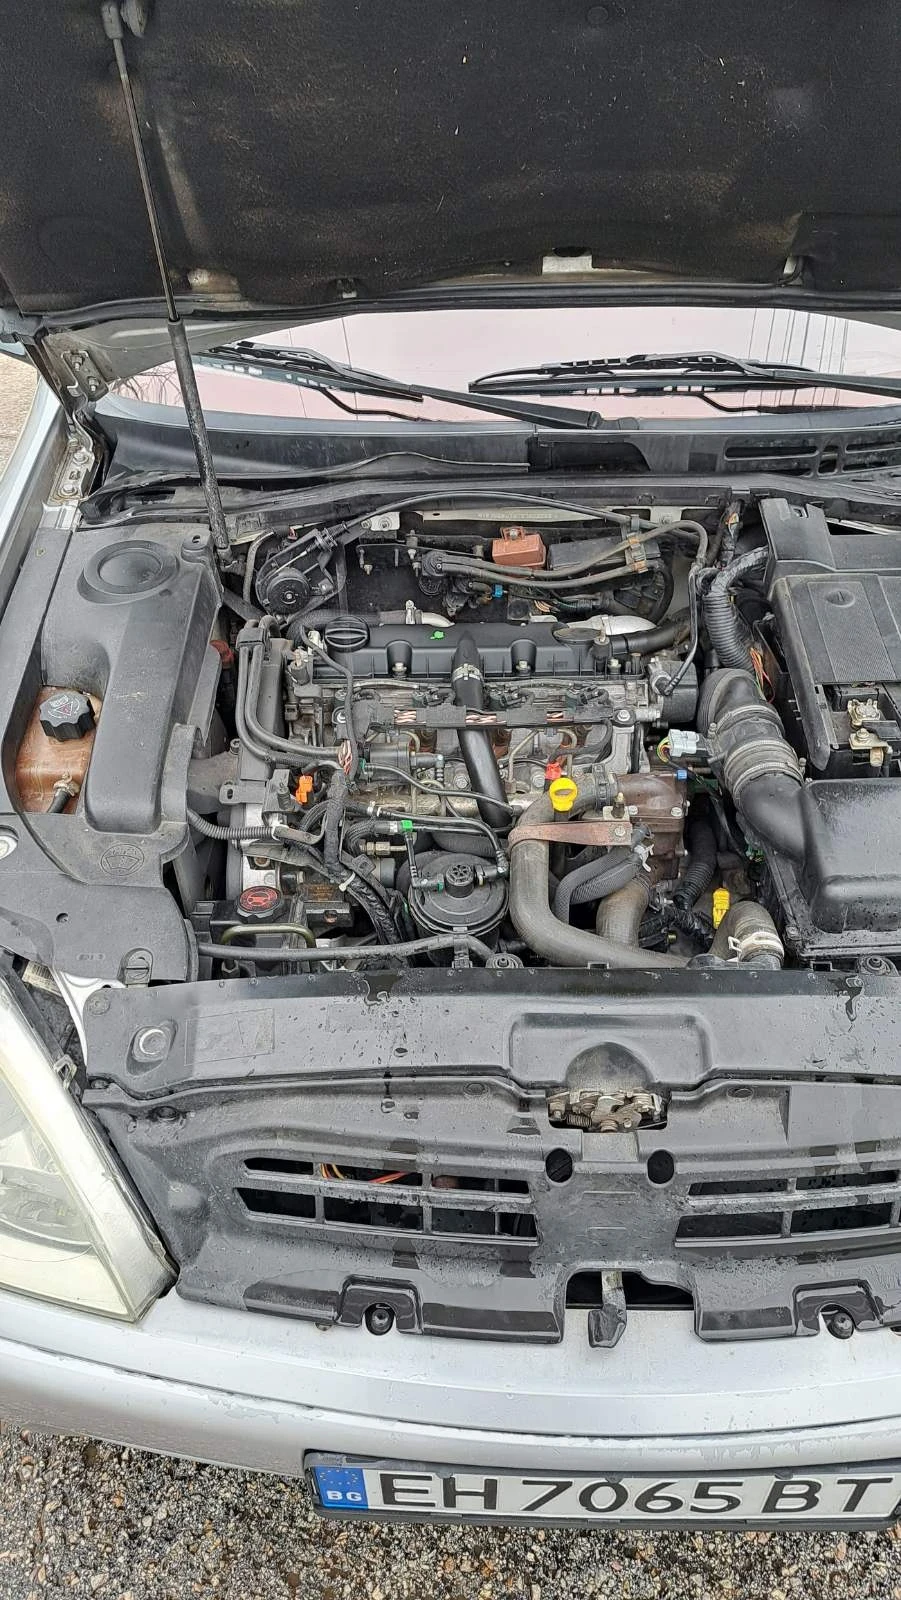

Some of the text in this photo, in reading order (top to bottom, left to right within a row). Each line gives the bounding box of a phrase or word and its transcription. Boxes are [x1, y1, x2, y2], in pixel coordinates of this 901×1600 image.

[326, 1490, 362, 1502] BG
[379, 1473, 894, 1513] EH 7065 BT
